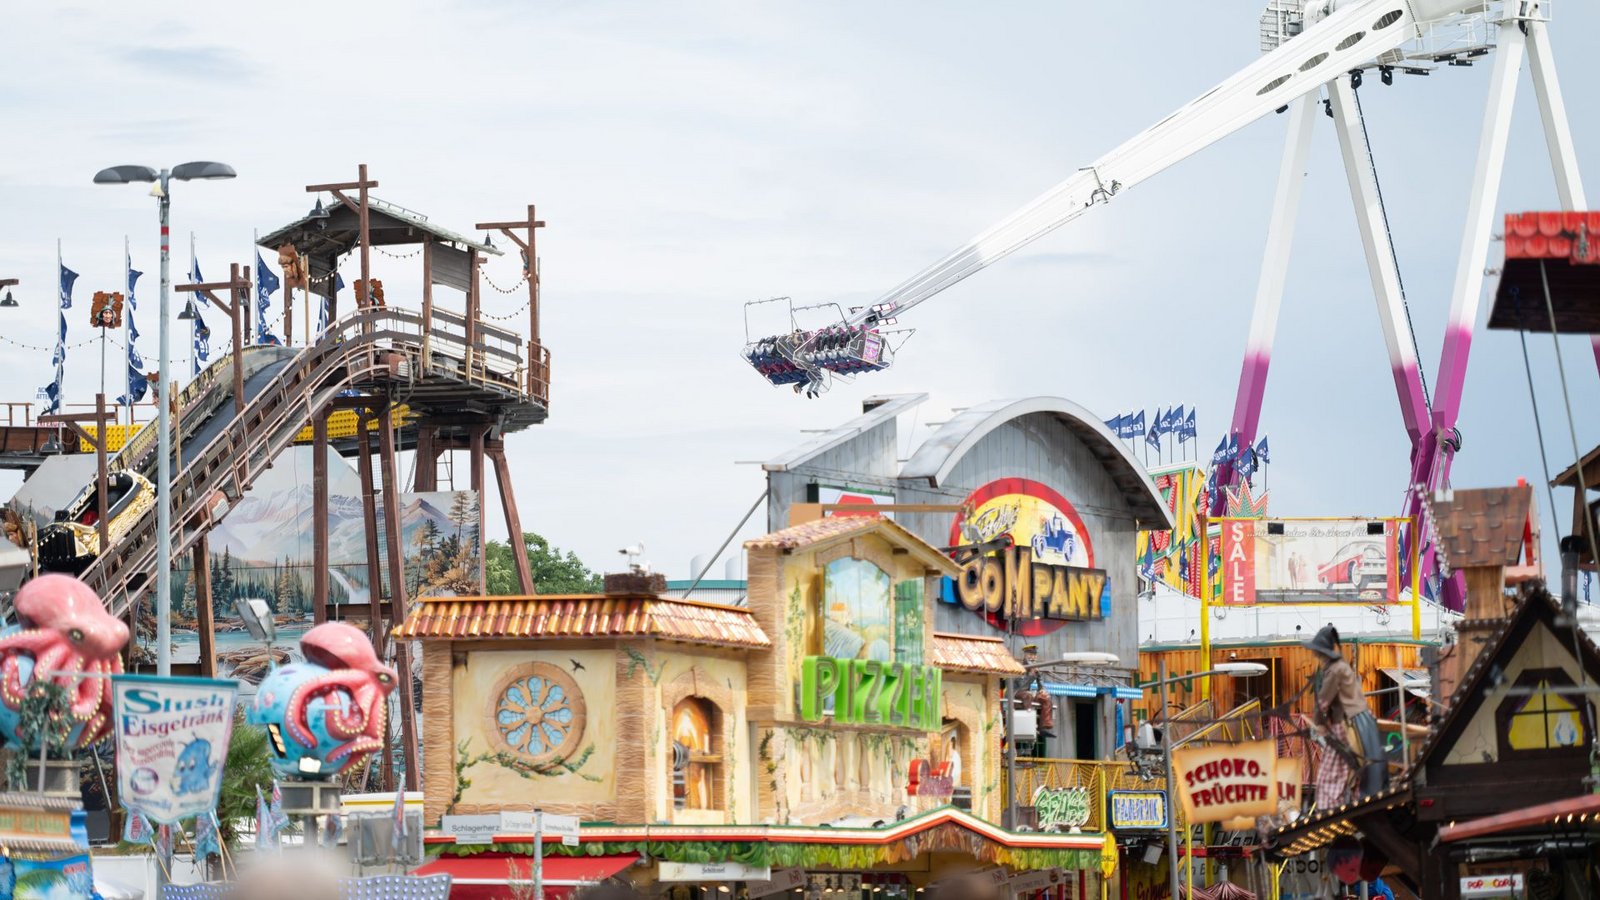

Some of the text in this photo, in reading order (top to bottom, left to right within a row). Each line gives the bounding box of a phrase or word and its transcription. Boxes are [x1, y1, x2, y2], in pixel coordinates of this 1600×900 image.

[1229, 522, 1247, 602] SALE
[958, 546, 1105, 619] COMPANY
[124, 689, 224, 714] Slush
[122, 708, 225, 738] Eisgetränk
[1185, 758, 1268, 788] SCHOKO-
[1191, 783, 1268, 808] FRÜCHTE
[451, 823, 500, 833] Schlagerherz
